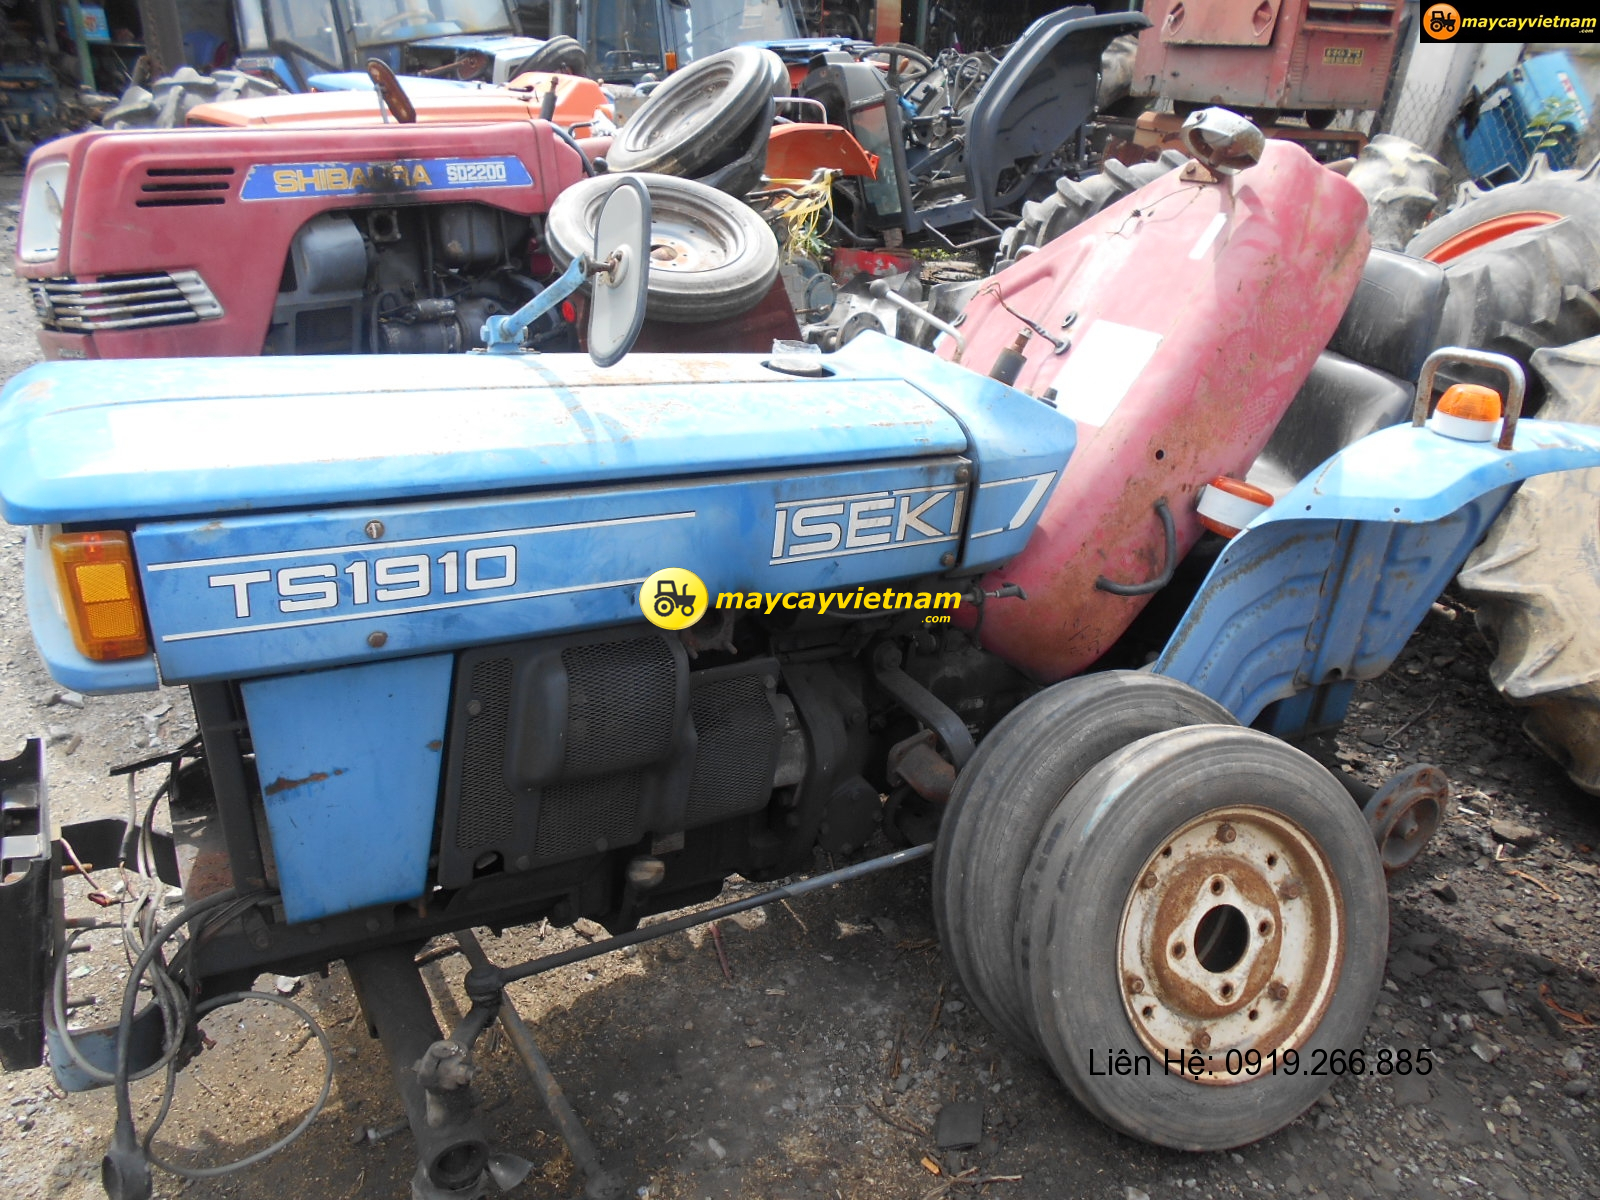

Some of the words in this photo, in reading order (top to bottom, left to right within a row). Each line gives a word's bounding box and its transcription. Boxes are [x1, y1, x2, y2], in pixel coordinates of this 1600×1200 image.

[446, 164, 507, 181] SD2200
[772, 488, 964, 558] ISEKI
[208, 545, 517, 618] TS1910
